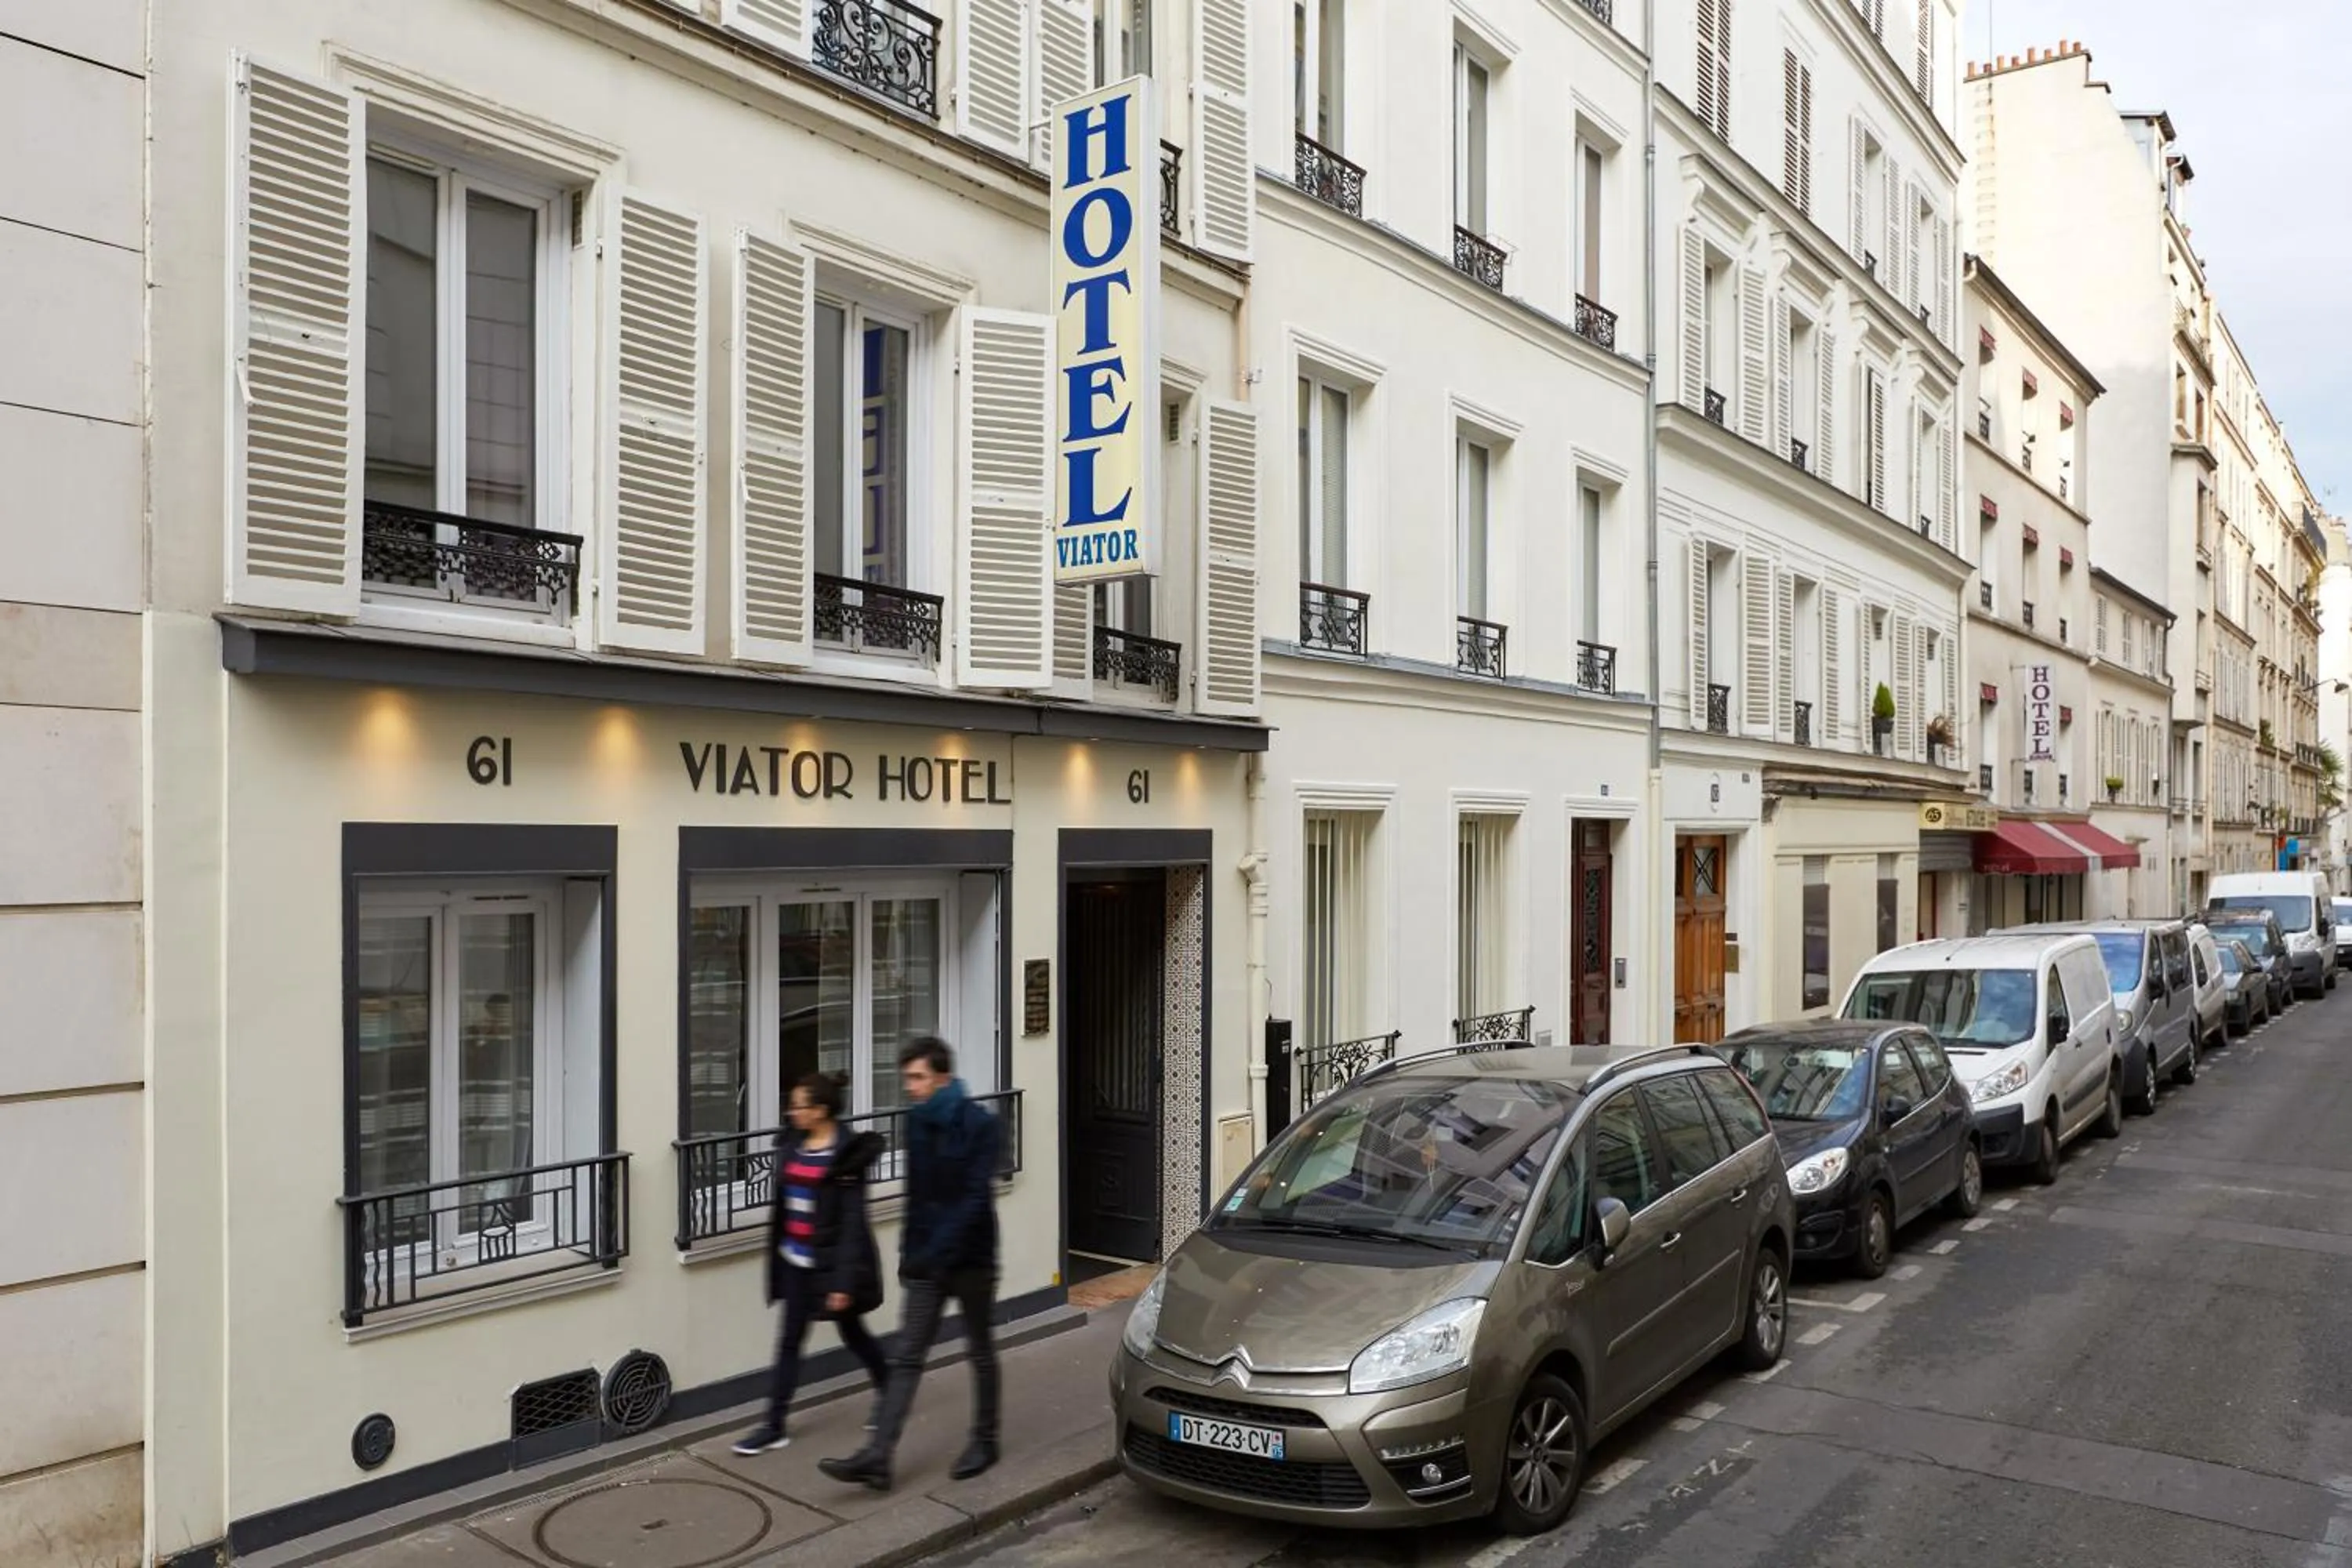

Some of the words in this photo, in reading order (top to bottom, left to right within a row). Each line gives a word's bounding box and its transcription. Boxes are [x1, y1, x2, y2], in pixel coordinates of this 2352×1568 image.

[1062, 93, 1132, 528] HOTEL
[1056, 529, 1138, 568] VIATOR
[2031, 666, 2050, 754] HOTEL
[466, 735, 512, 786] 61
[679, 741, 854, 800] VIATOR
[878, 754, 1012, 805] HOTEL
[1127, 769, 1149, 804] 61
